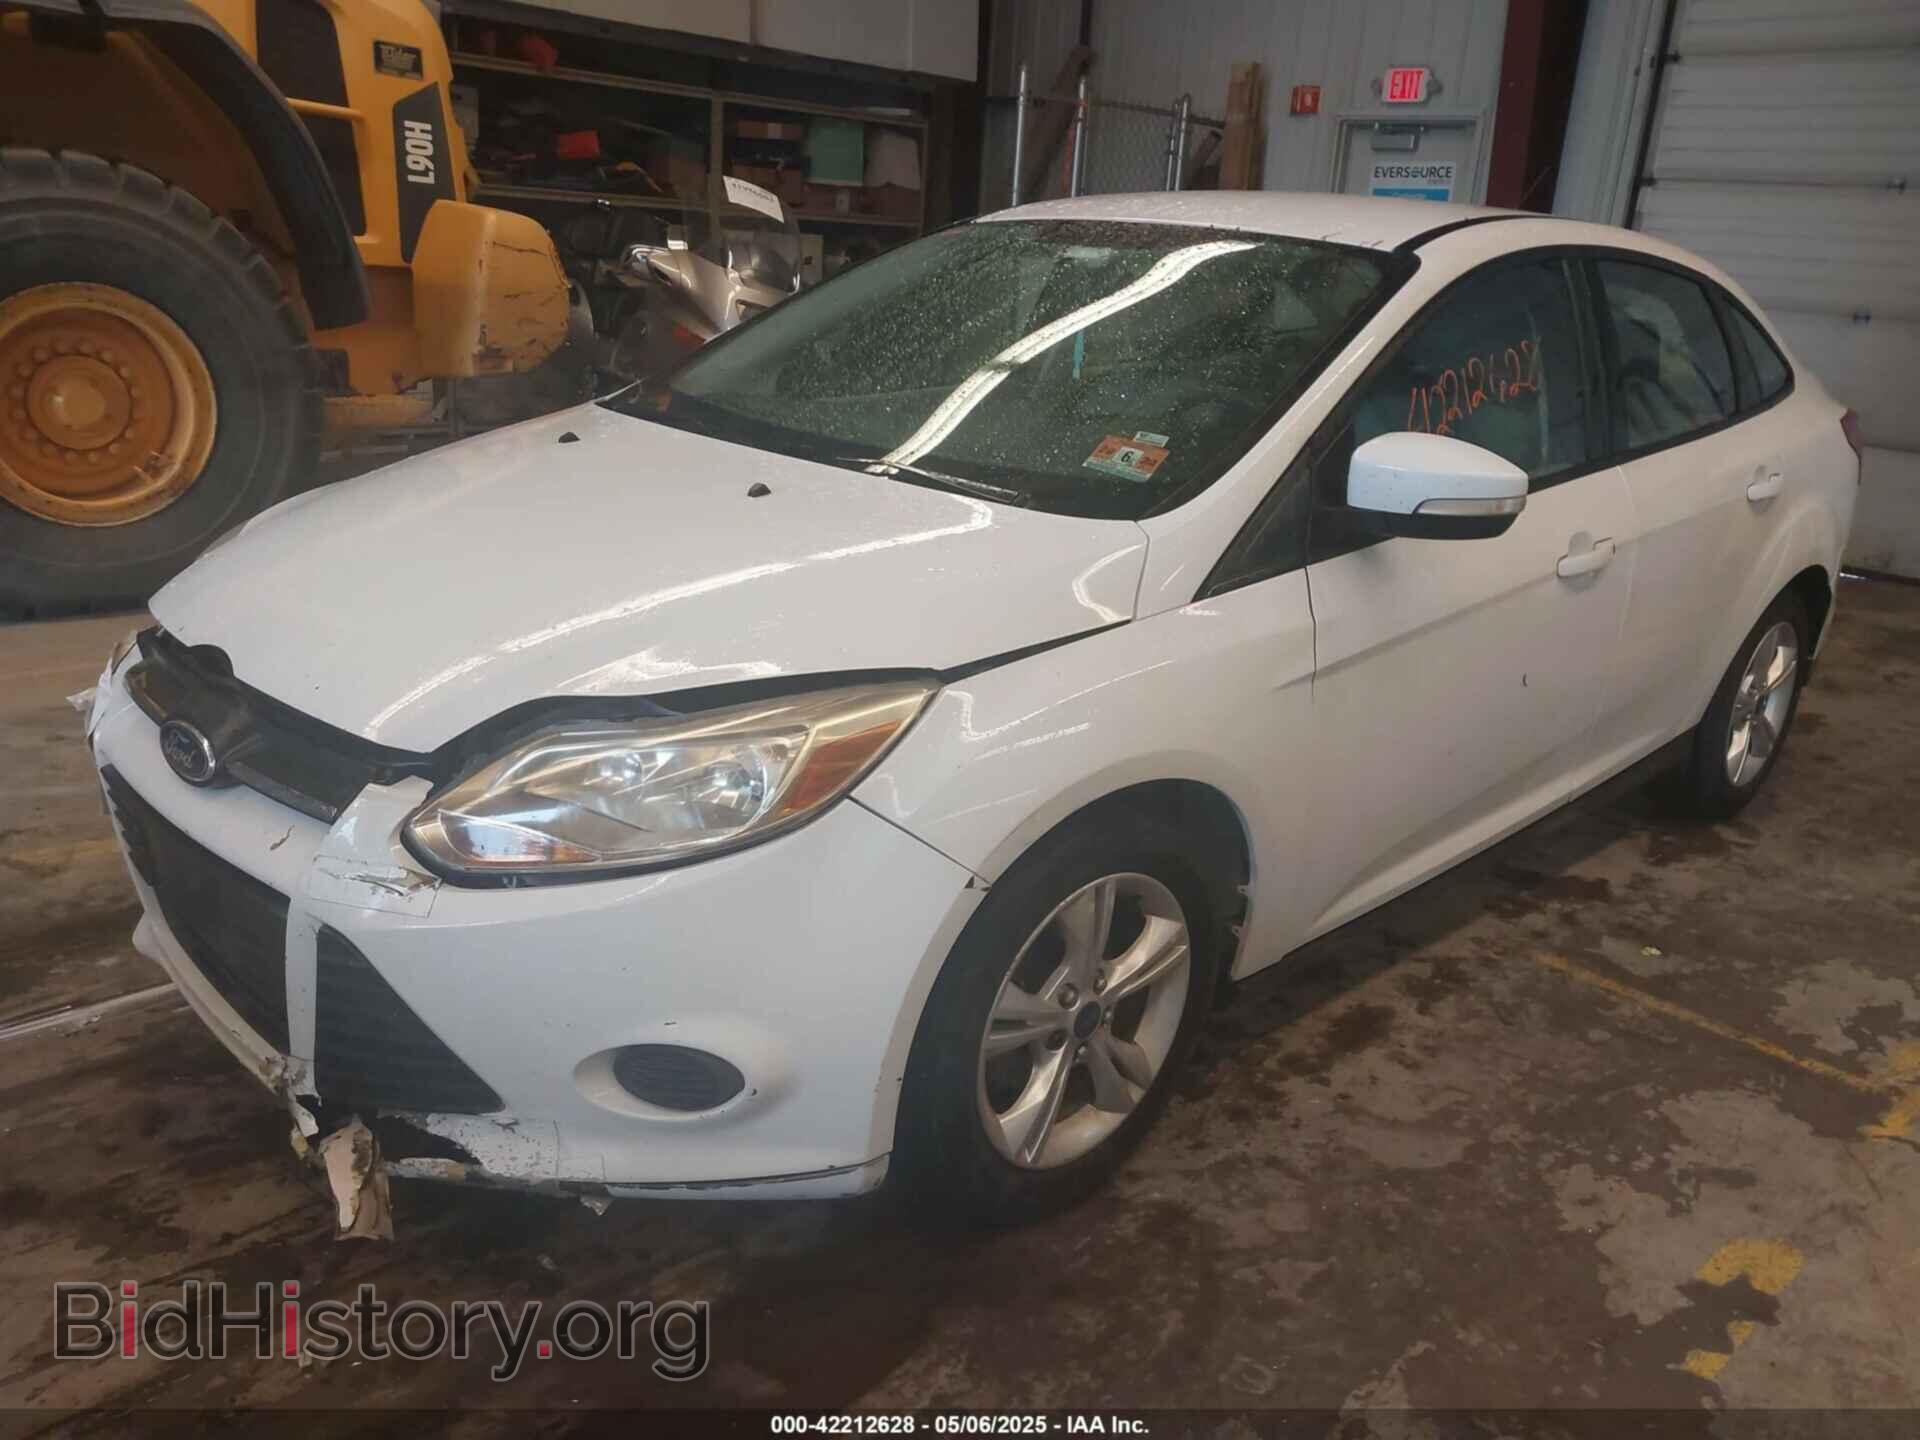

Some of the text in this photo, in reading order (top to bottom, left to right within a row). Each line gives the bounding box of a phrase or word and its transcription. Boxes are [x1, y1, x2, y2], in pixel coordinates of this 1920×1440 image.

[1389, 69, 1424, 100] EXIT
[404, 120, 436, 185] L90H
[1373, 165, 1453, 179] EVERSOURCE
[1121, 451, 1134, 463] 6
